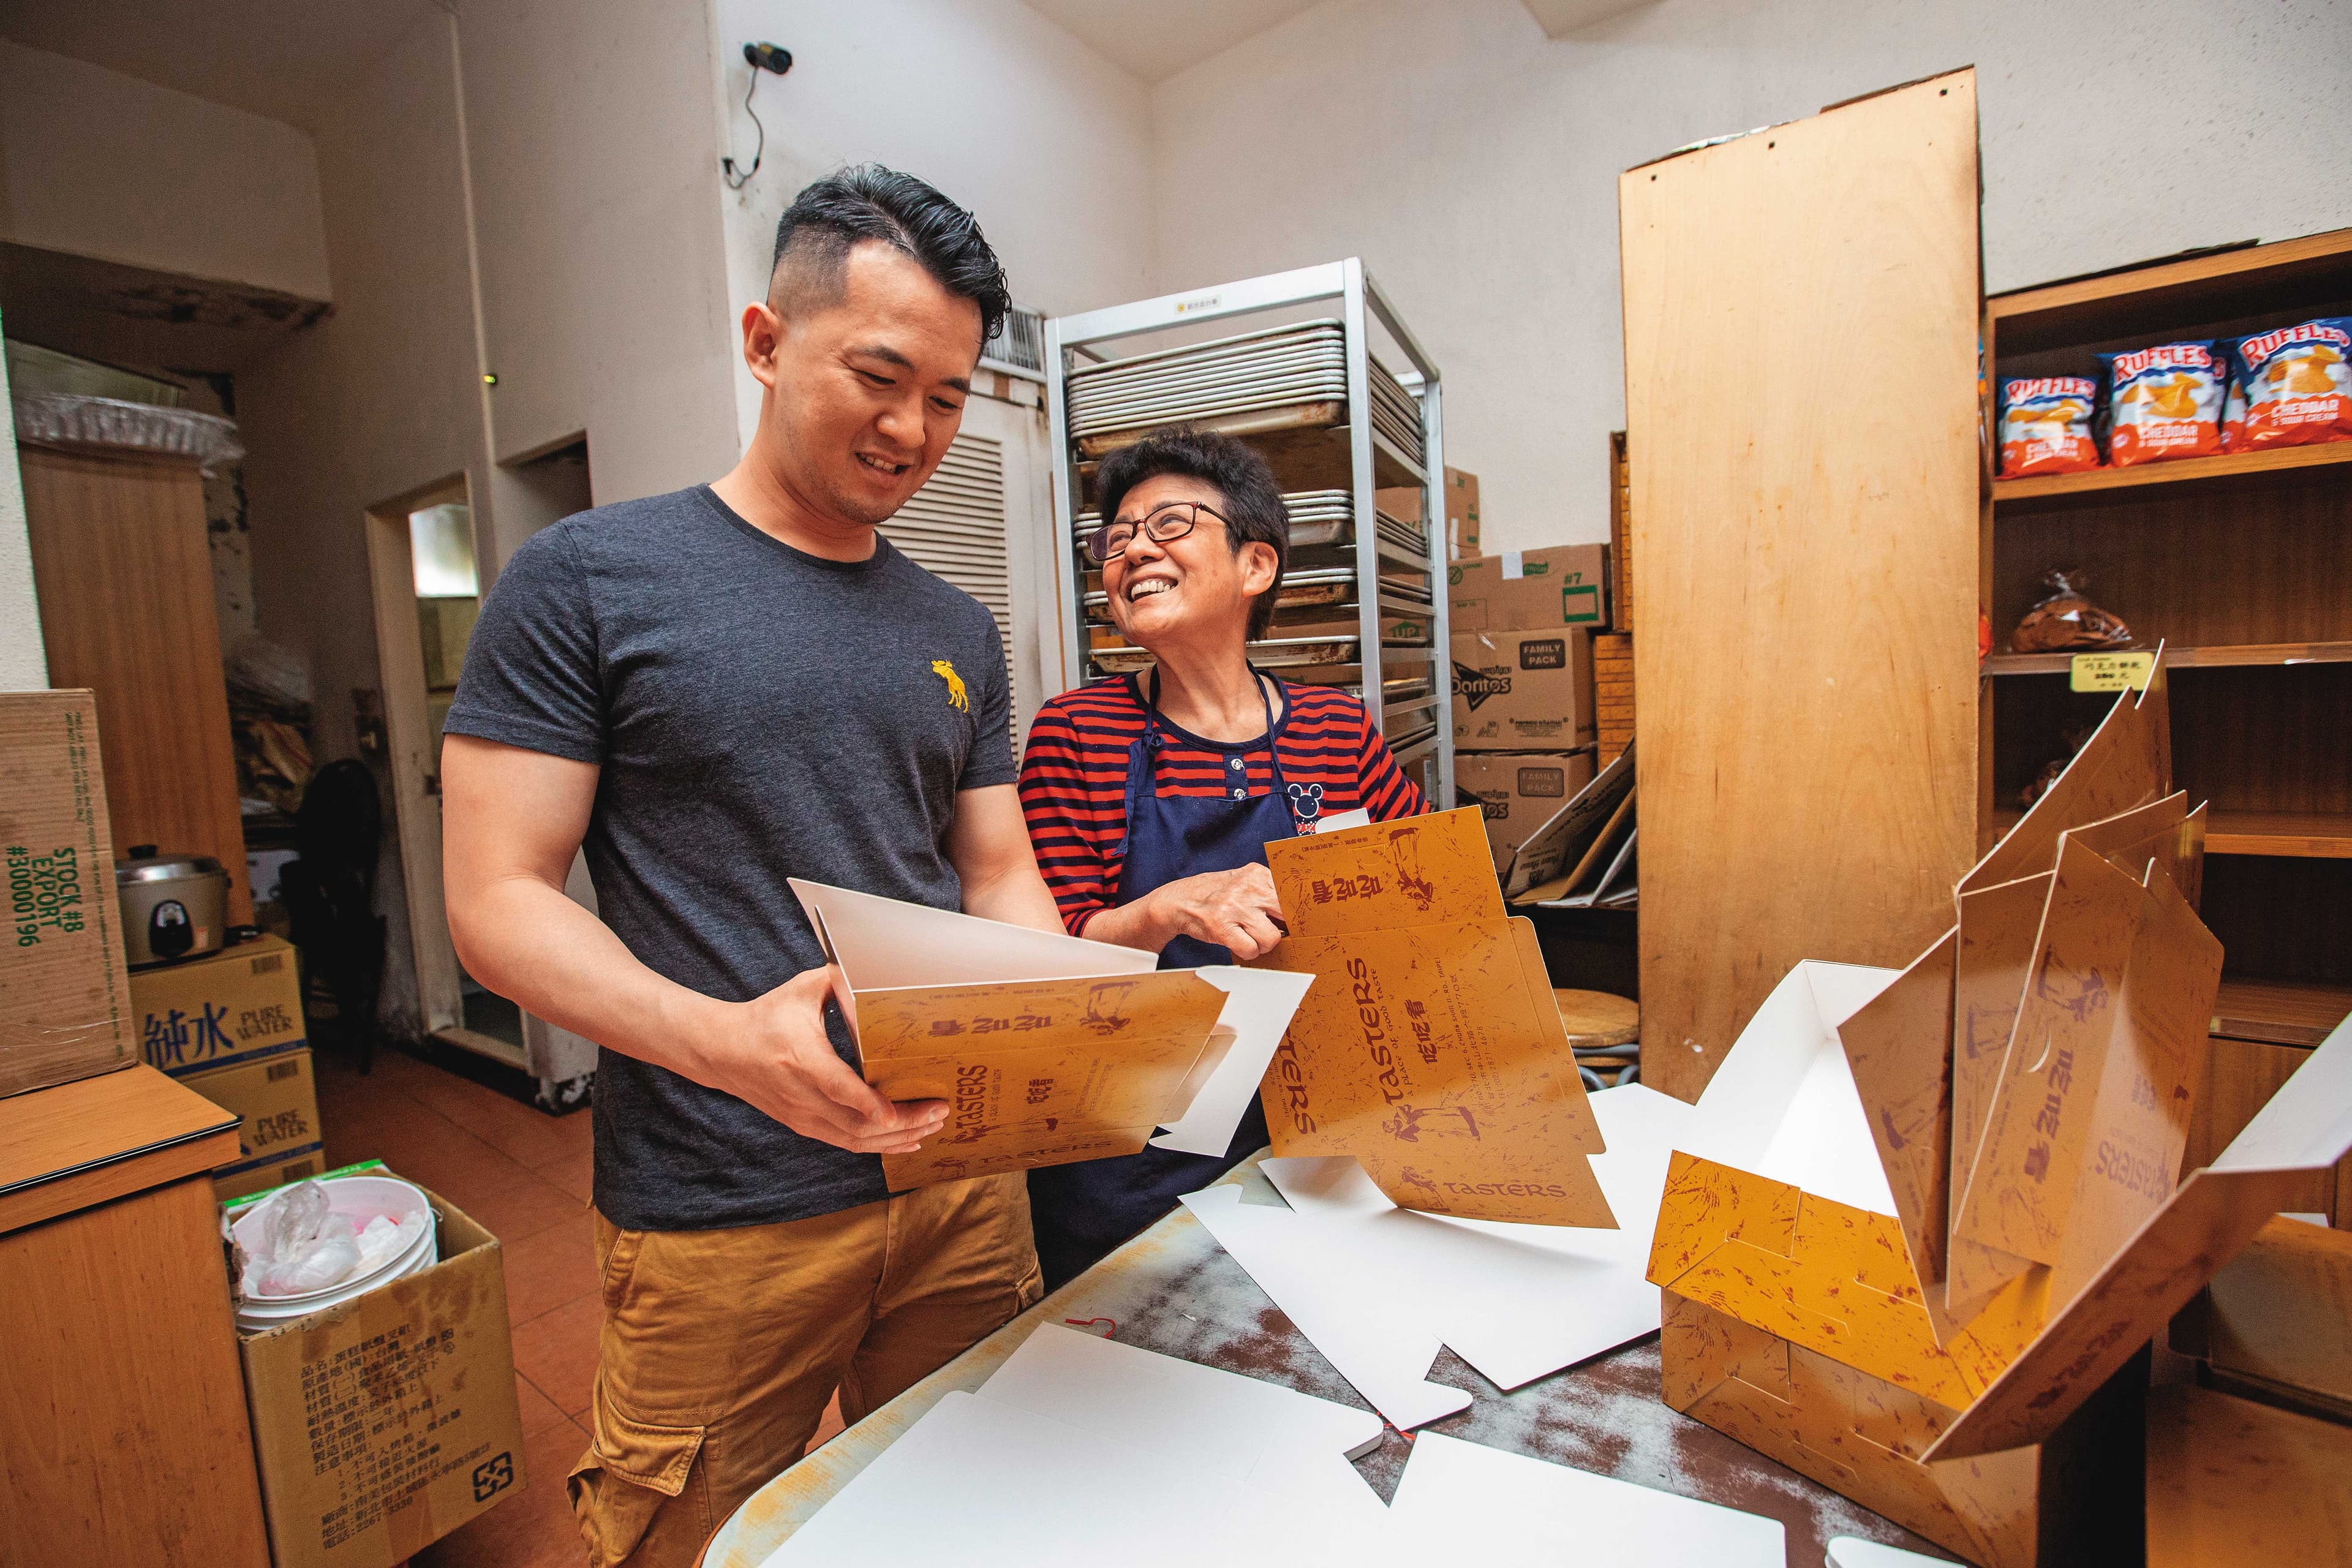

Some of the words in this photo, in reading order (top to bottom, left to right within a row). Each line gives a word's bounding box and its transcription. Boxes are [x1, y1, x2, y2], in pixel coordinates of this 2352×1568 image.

[2239, 323, 2350, 369] RUFFLES
[2114, 347, 2212, 382] RUFFLES
[2007, 377, 2095, 401] RUFFLES
[1524, 644, 1561, 653] FAMILY
[1529, 656, 1556, 665] PACK
[1452, 677, 1512, 695] Doritos
[31, 858, 62, 927] EXPORT
[53, 847, 83, 908] STOCK
[1312, 874, 1384, 905] 吃吃看
[6, 846, 41, 947] #30000196
[62, 911, 85, 932] #8
[143, 1001, 235, 1070] 純水
[1404, 998, 1439, 1065] 吃吃看
[955, 1065, 988, 1129] TASTERS
[1025, 1078, 1054, 1105] 吃吃看
[1278, 1026, 1316, 1135] TERS
[1442, 1181, 1567, 1199] TASTERS
